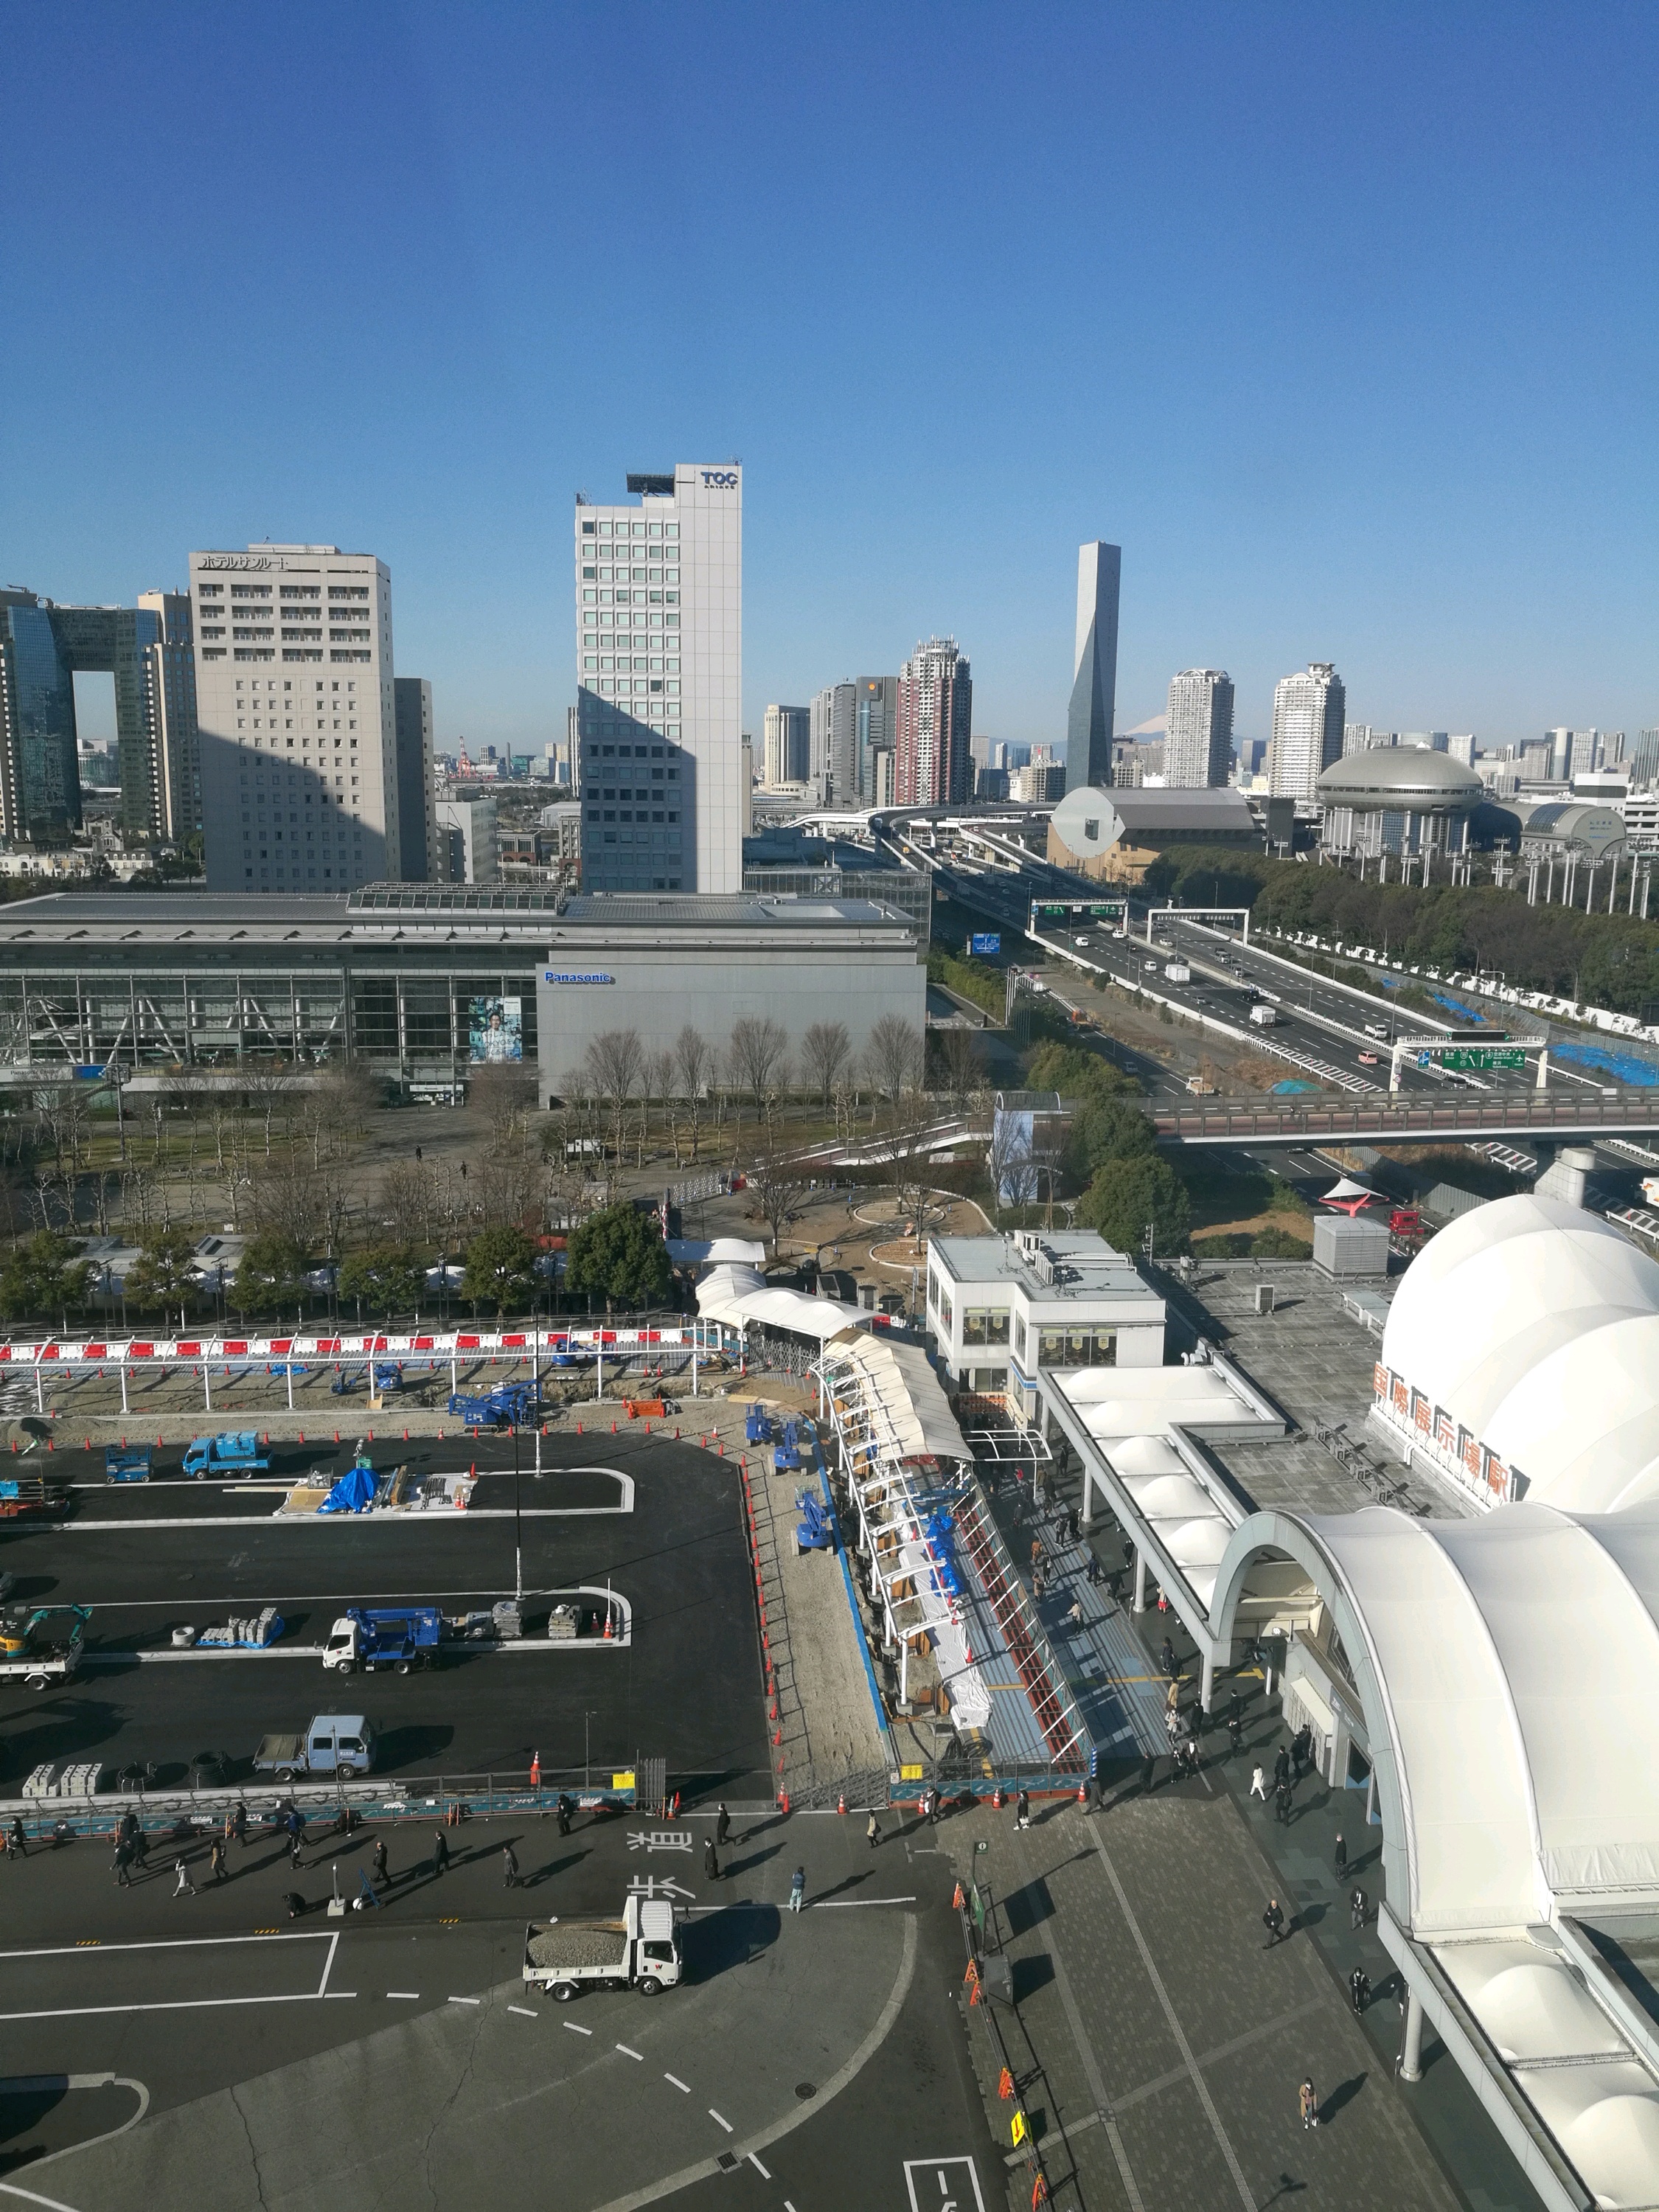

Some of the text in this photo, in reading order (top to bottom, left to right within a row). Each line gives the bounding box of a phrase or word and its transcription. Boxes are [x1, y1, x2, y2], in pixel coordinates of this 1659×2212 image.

[700, 472, 738, 484] TOC
[203, 556, 288, 568] ホテルサンルート
[545, 971, 611, 982] Panasonic
[1374, 1363, 1509, 1502] 国際展示場駅
[627, 1832, 696, 1899] 歩道
